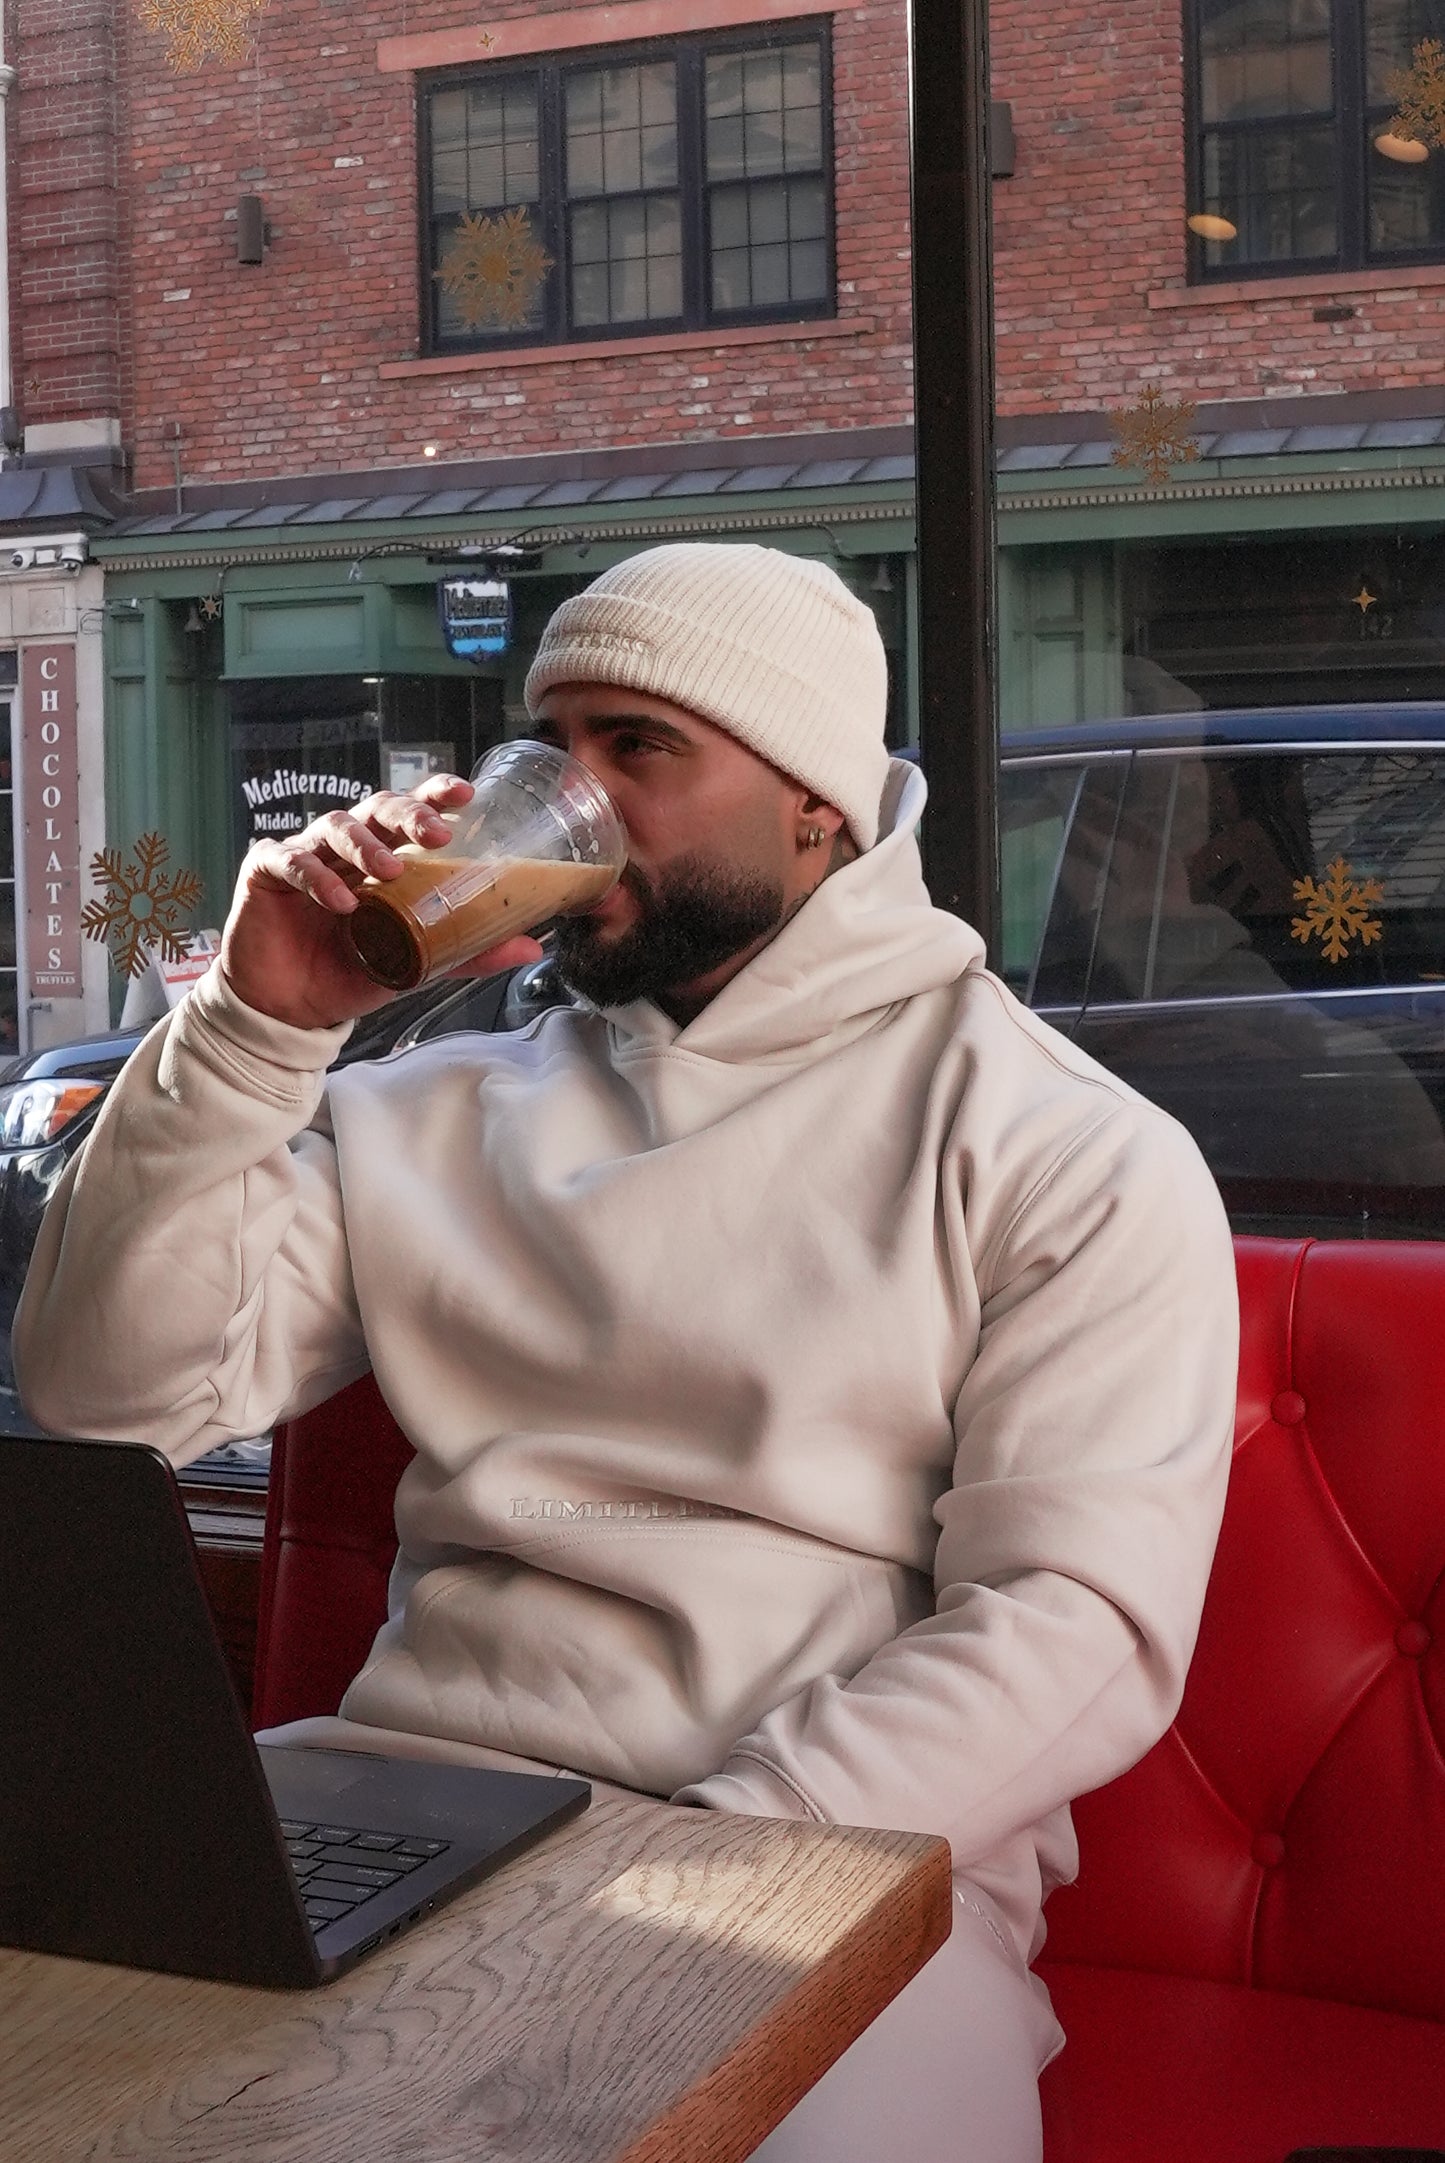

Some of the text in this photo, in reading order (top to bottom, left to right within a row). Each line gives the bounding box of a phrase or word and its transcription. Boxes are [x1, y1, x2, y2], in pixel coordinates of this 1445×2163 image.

[242, 769, 373, 808] Mediterranea
[40, 657, 63, 970] CHOCOLATES
[254, 812, 302, 831] Middle
